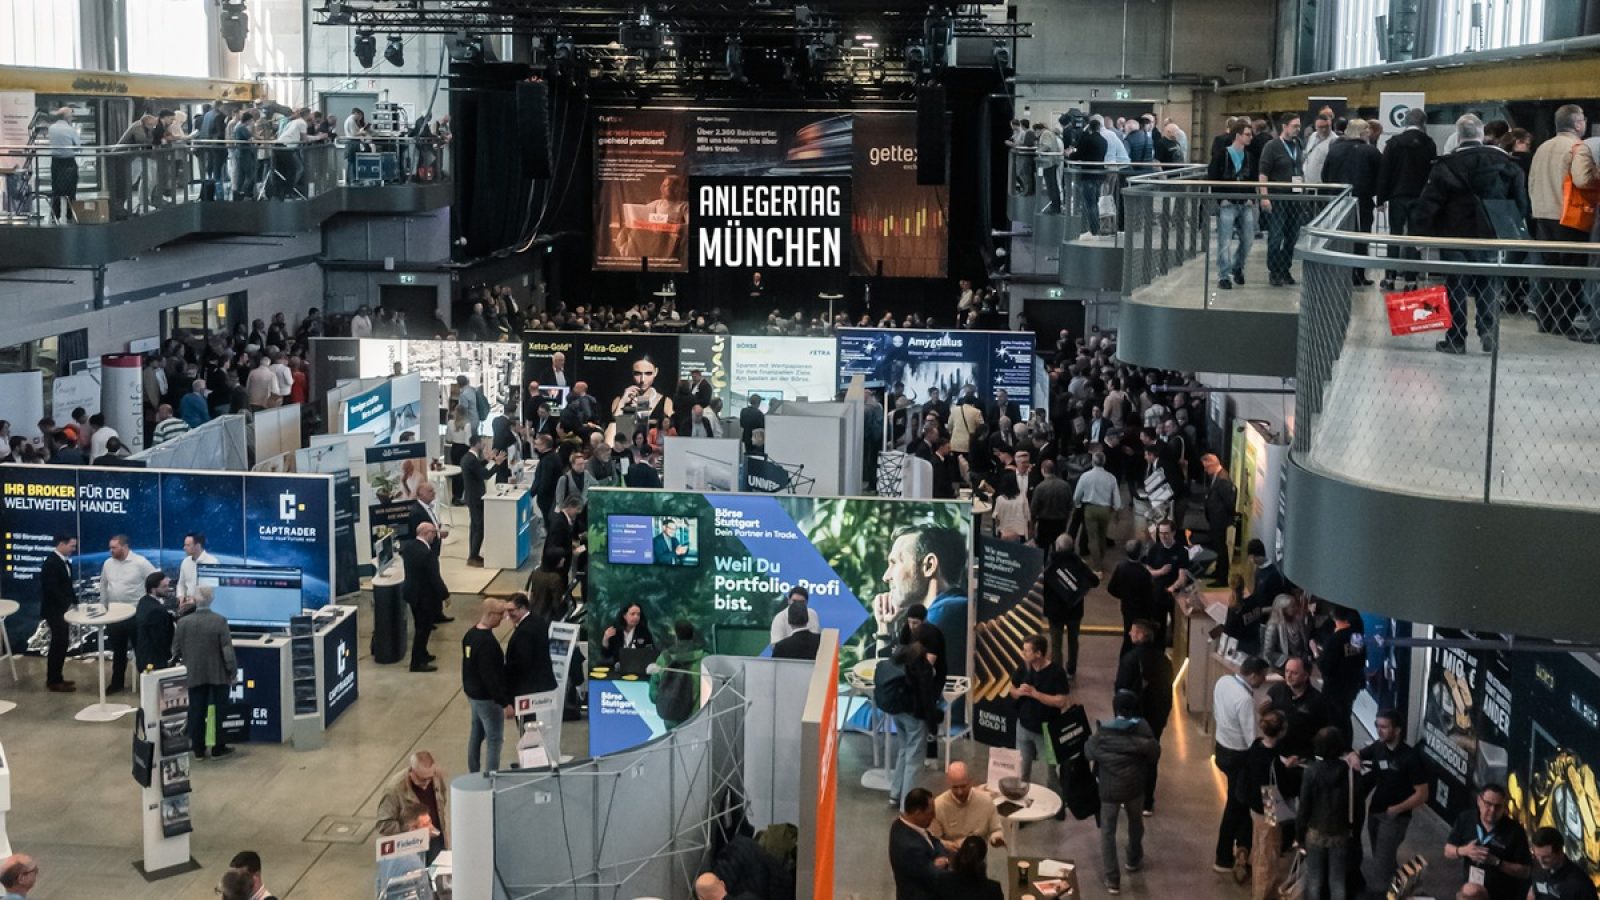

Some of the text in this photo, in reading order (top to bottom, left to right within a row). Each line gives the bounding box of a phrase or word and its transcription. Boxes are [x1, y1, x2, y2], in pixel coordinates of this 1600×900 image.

[699, 185, 841, 216] ANLEGERTAG
[699, 219, 841, 268] MÜNCHEN
[4, 483, 130, 500] IHR BROKER FÜR DEN
[4, 497, 127, 514] WELTWEITEN HANDEL
[715, 507, 743, 518] Börse
[714, 517, 760, 529] Stuttgart
[259, 526, 317, 537] CAPTRADER
[714, 528, 799, 540] Dein Partner in Trade.
[714, 556, 781, 574] Weil Du
[714, 594, 752, 612] bist.
[601, 691, 624, 700] Börse
[601, 699, 636, 709] Stuttgart
[979, 718, 1001, 730] GOLD
